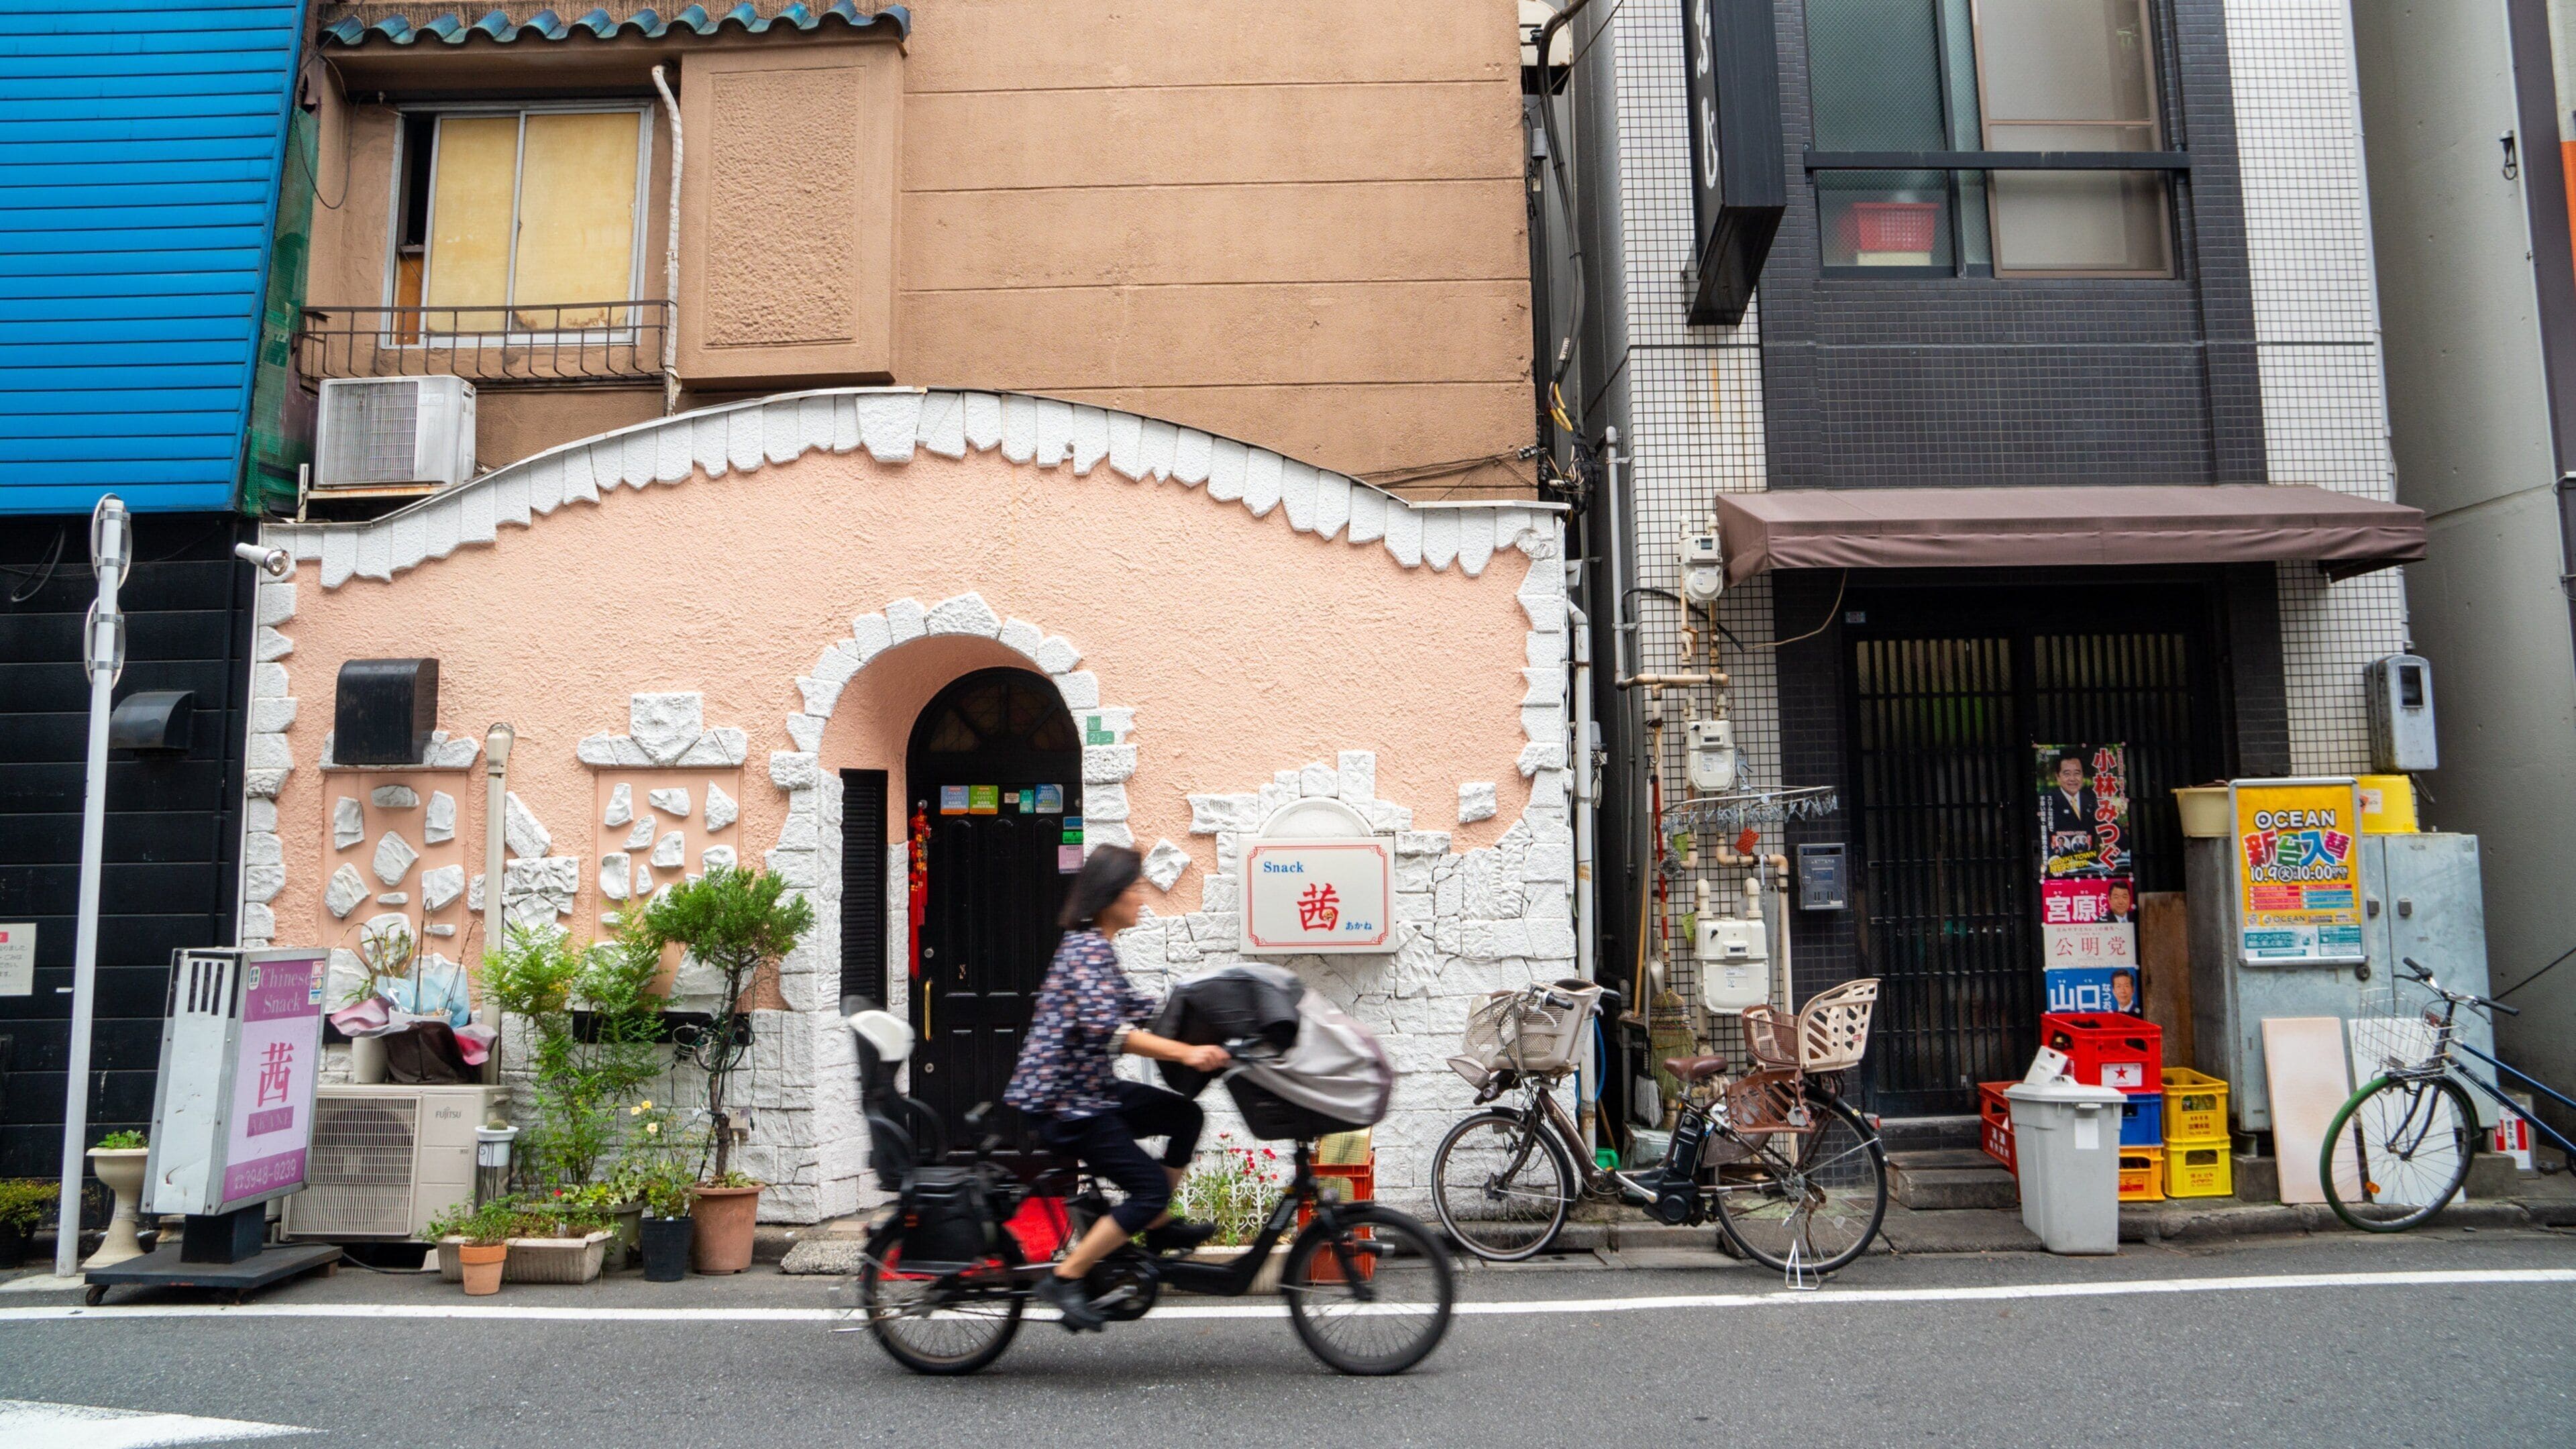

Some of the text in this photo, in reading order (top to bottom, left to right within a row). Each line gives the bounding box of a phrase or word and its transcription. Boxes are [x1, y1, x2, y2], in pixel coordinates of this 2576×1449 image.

[2092, 748, 2121, 871] 小林みつぐ
[2255, 810, 2336, 828] OCEAN
[2074, 851, 2096, 860] TOWN
[2243, 829, 2352, 867] 新台入替
[1263, 861, 1304, 873] Snack
[1297, 883, 1340, 932] 茜
[2046, 895, 2098, 922] 宮原
[2098, 893, 2108, 921] よしひこ
[2273, 915, 2306, 923] OCEAN
[1345, 921, 1373, 930] あかね
[2055, 936, 2126, 956] 公明党
[260, 968, 312, 988] Chinese
[263, 993, 301, 1014] Snack
[2049, 984, 2100, 1012] 山口
[2102, 983, 2112, 1010] なつお
[258, 1042, 294, 1108] 茜
[435, 1107, 462, 1120] FUJITSU
[244, 1159, 297, 1190] 3948-0239
